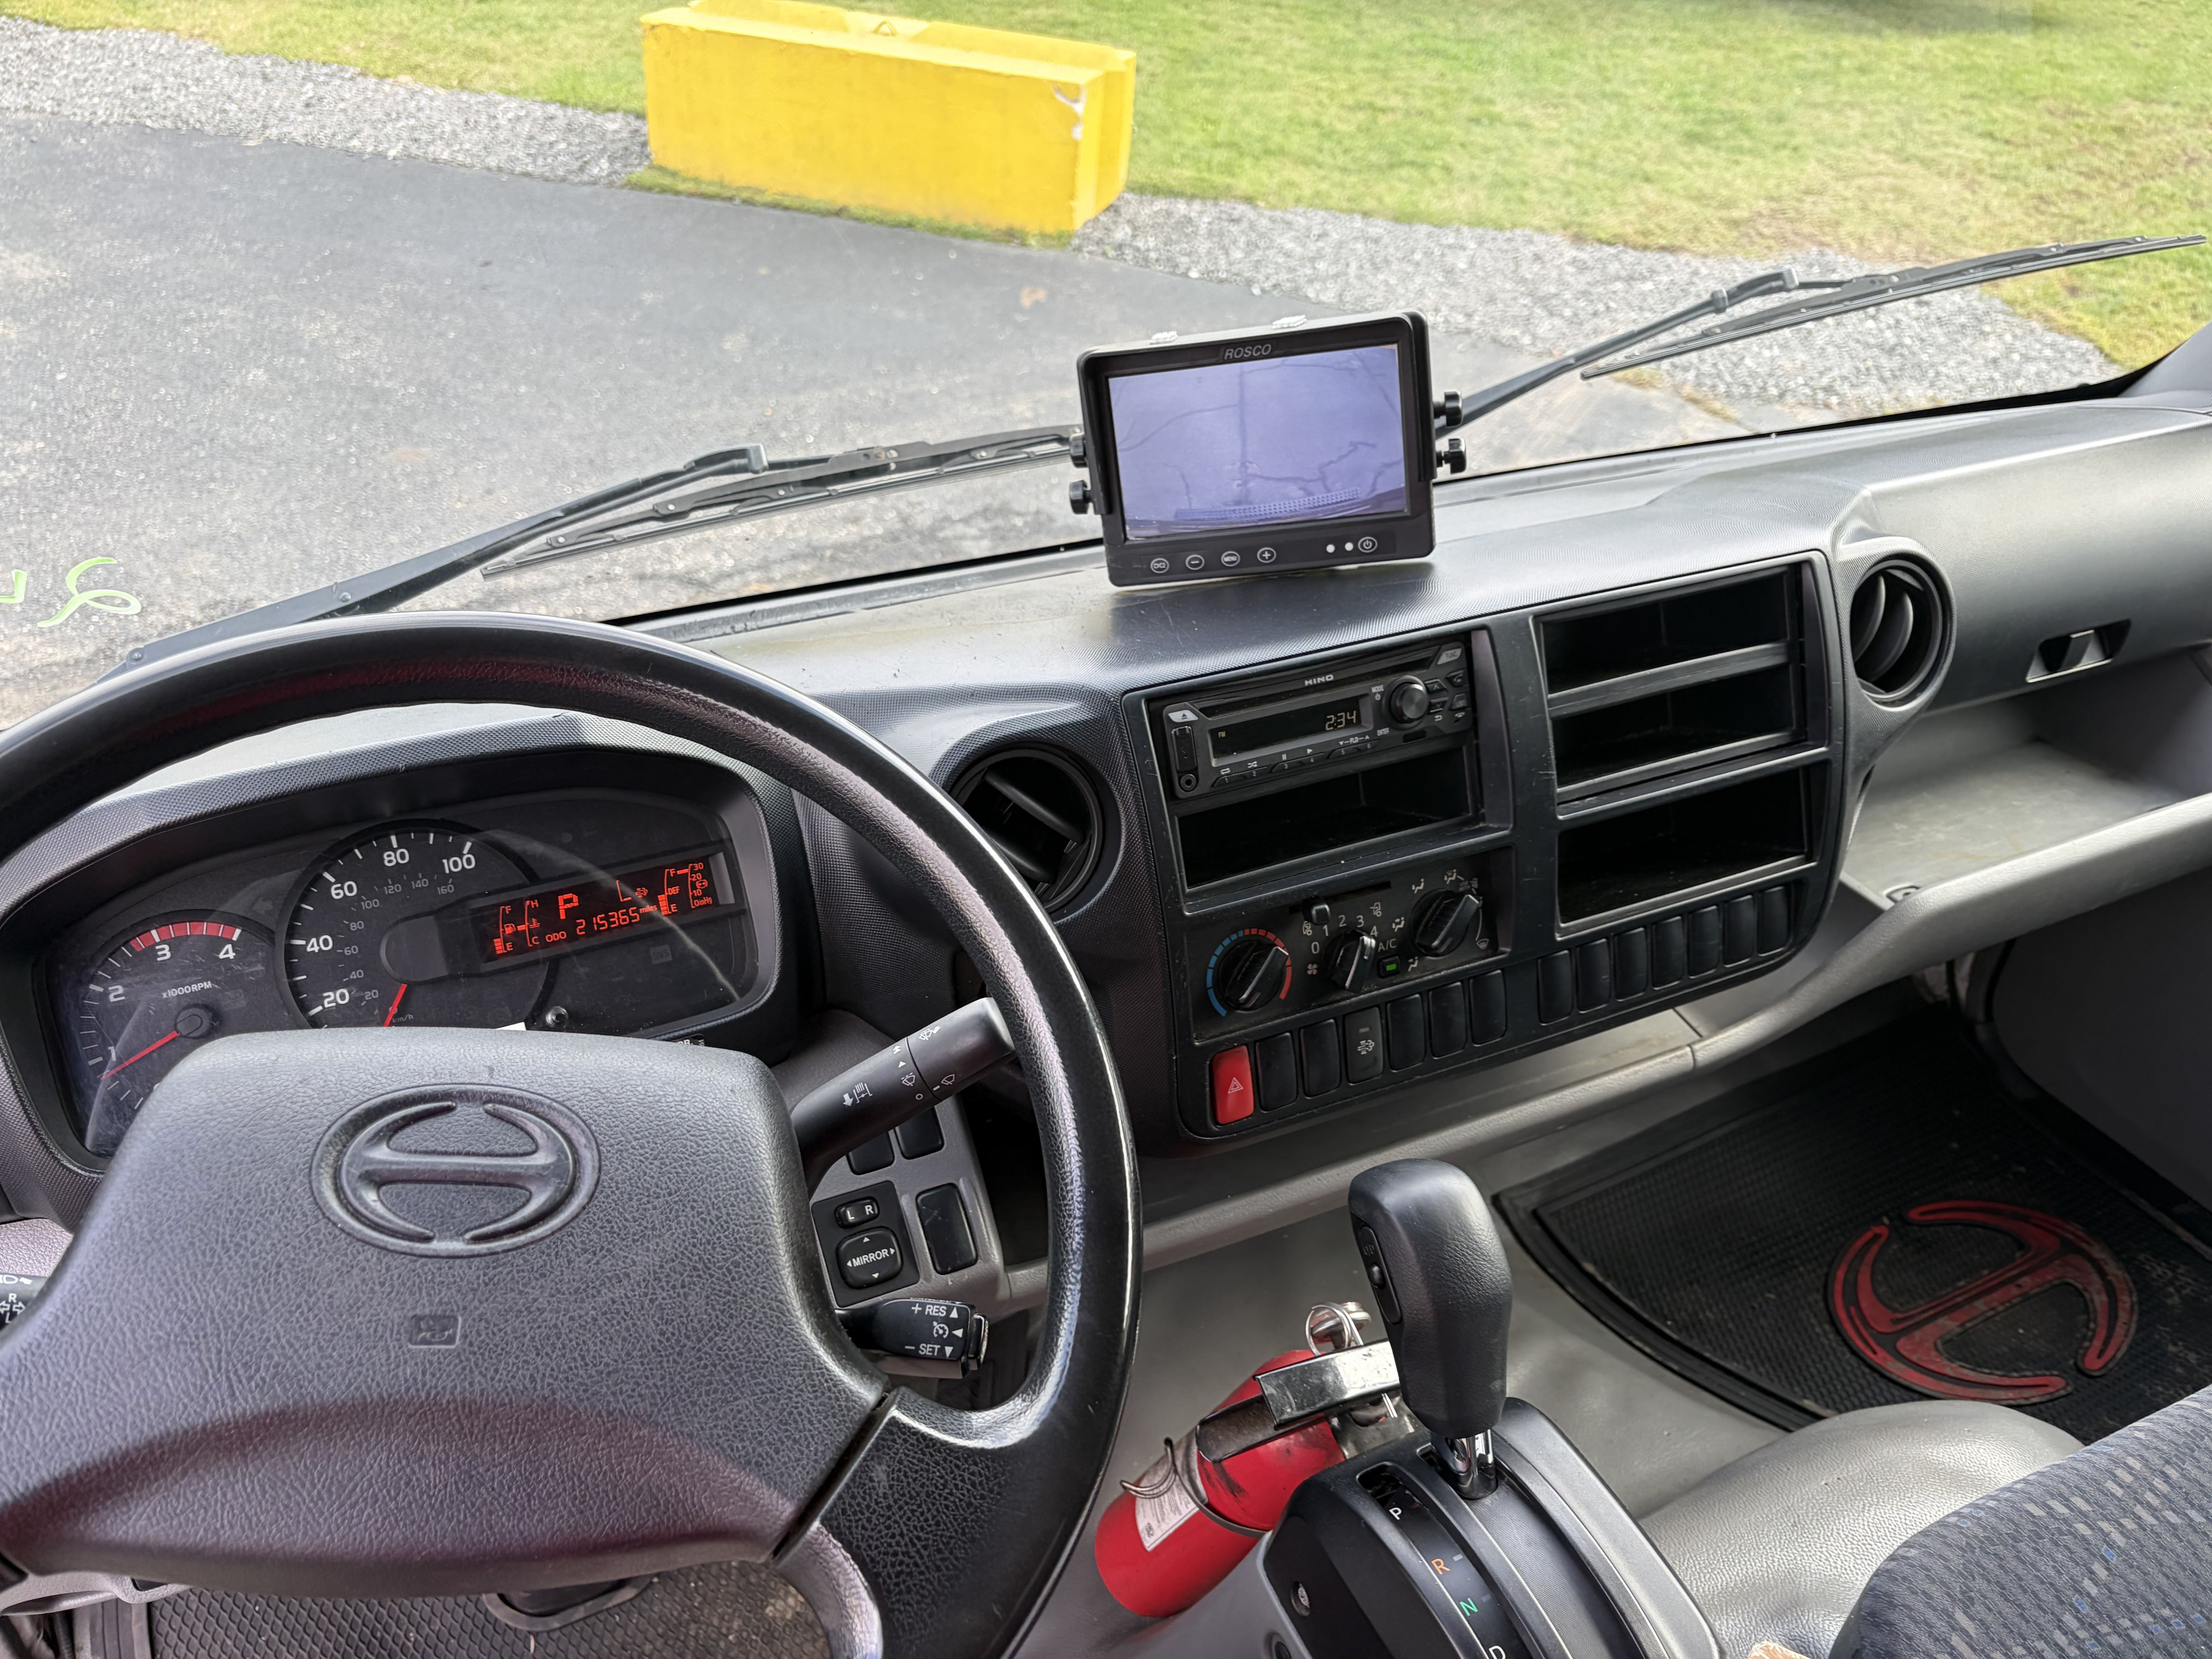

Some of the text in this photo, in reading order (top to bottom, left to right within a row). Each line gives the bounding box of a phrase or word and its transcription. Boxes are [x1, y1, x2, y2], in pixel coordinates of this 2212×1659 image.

[1224, 344, 1272, 360] ROSCO
[1304, 674, 1334, 686] HINO
[1371, 685, 1384, 693] MODE
[1326, 711, 1357, 731] 2:34
[1377, 728, 1389, 736] ENTER
[383, 848, 409, 866] 80
[442, 854, 476, 873] 100
[692, 862, 704, 871] 30
[669, 868, 676, 877] F
[691, 873, 702, 881] 20
[384, 884, 402, 895] 120
[411, 879, 429, 889] 140
[437, 884, 455, 895] 160
[331, 881, 357, 899] 60
[667, 886, 680, 895] DEF
[361, 899, 380, 910] 100
[531, 899, 539, 908] H
[558, 893, 579, 920] P
[670, 903, 677, 912] E
[505, 905, 512, 914] F
[350, 921, 364, 931] 80
[545, 905, 658, 943] ODO 215365 miles
[1338, 915, 1346, 927] 2
[1357, 915, 1364, 927] 3
[1323, 925, 1328, 936] 1
[1370, 926, 1378, 937] 4
[307, 935, 333, 953] 40
[532, 936, 539, 945] C
[1378, 939, 1397, 952] A/C
[219, 944, 236, 959] 4
[344, 946, 358, 955] 60
[506, 942, 513, 951] E
[1311, 942, 1319, 954] 0
[155, 944, 171, 961] 3
[350, 970, 364, 979] 40
[108, 985, 125, 1002] 2
[323, 988, 349, 1008] 20
[365, 989, 379, 1000] 20
[108, 1046, 116, 1061] 1
[847, 1210, 855, 1220] L
[865, 1205, 874, 1215] R
[852, 1249, 890, 1267] MIRROR
[8, 1293, 17, 1303] R
[925, 1305, 947, 1317] RES
[5, 1312, 12, 1323] L
[919, 1343, 941, 1356] SET
[1389, 1507, 1402, 1520] P
[1431, 1558, 1450, 1575] R
[1460, 1598, 1479, 1616] N
[1489, 1645, 1506, 1659] D
